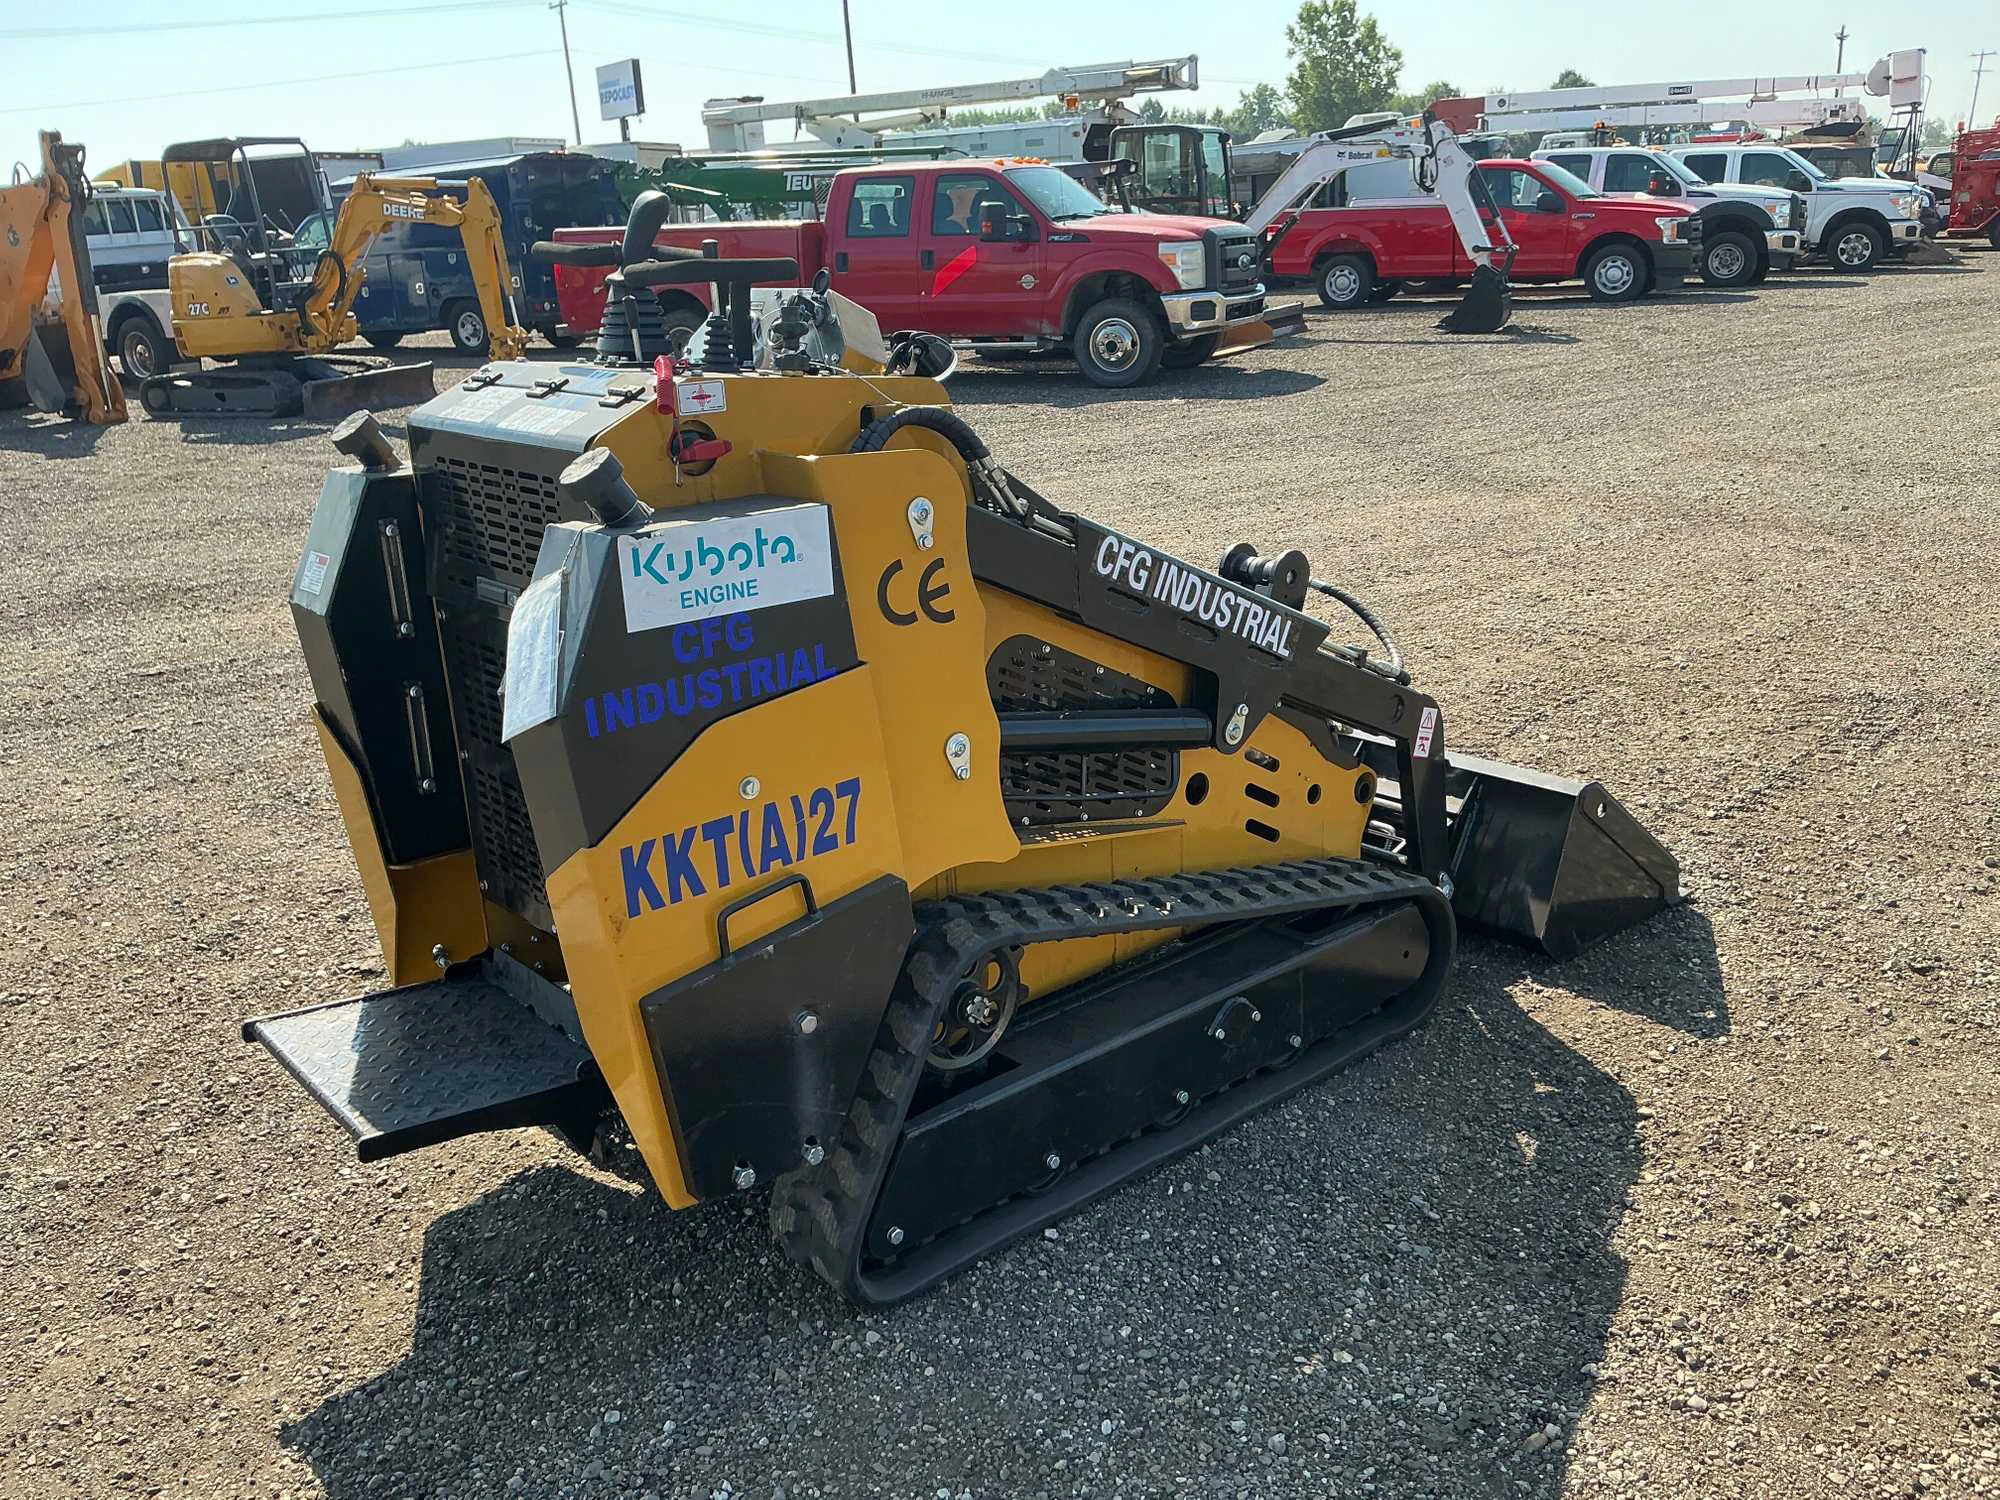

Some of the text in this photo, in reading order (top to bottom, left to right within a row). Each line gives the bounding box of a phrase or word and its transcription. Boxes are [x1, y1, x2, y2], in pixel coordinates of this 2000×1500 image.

[1348, 151, 1373, 160] Bobcat
[383, 203, 425, 220] DEERE
[631, 527, 796, 585] Kubota
[680, 579, 759, 610] ENGINE
[877, 558, 956, 626] CE
[1097, 535, 1293, 657] CFG INDUSTRIAL
[672, 612, 754, 664] CFG
[584, 644, 838, 737] INDUSTRIAL
[620, 777, 861, 919] KKT(A)27
